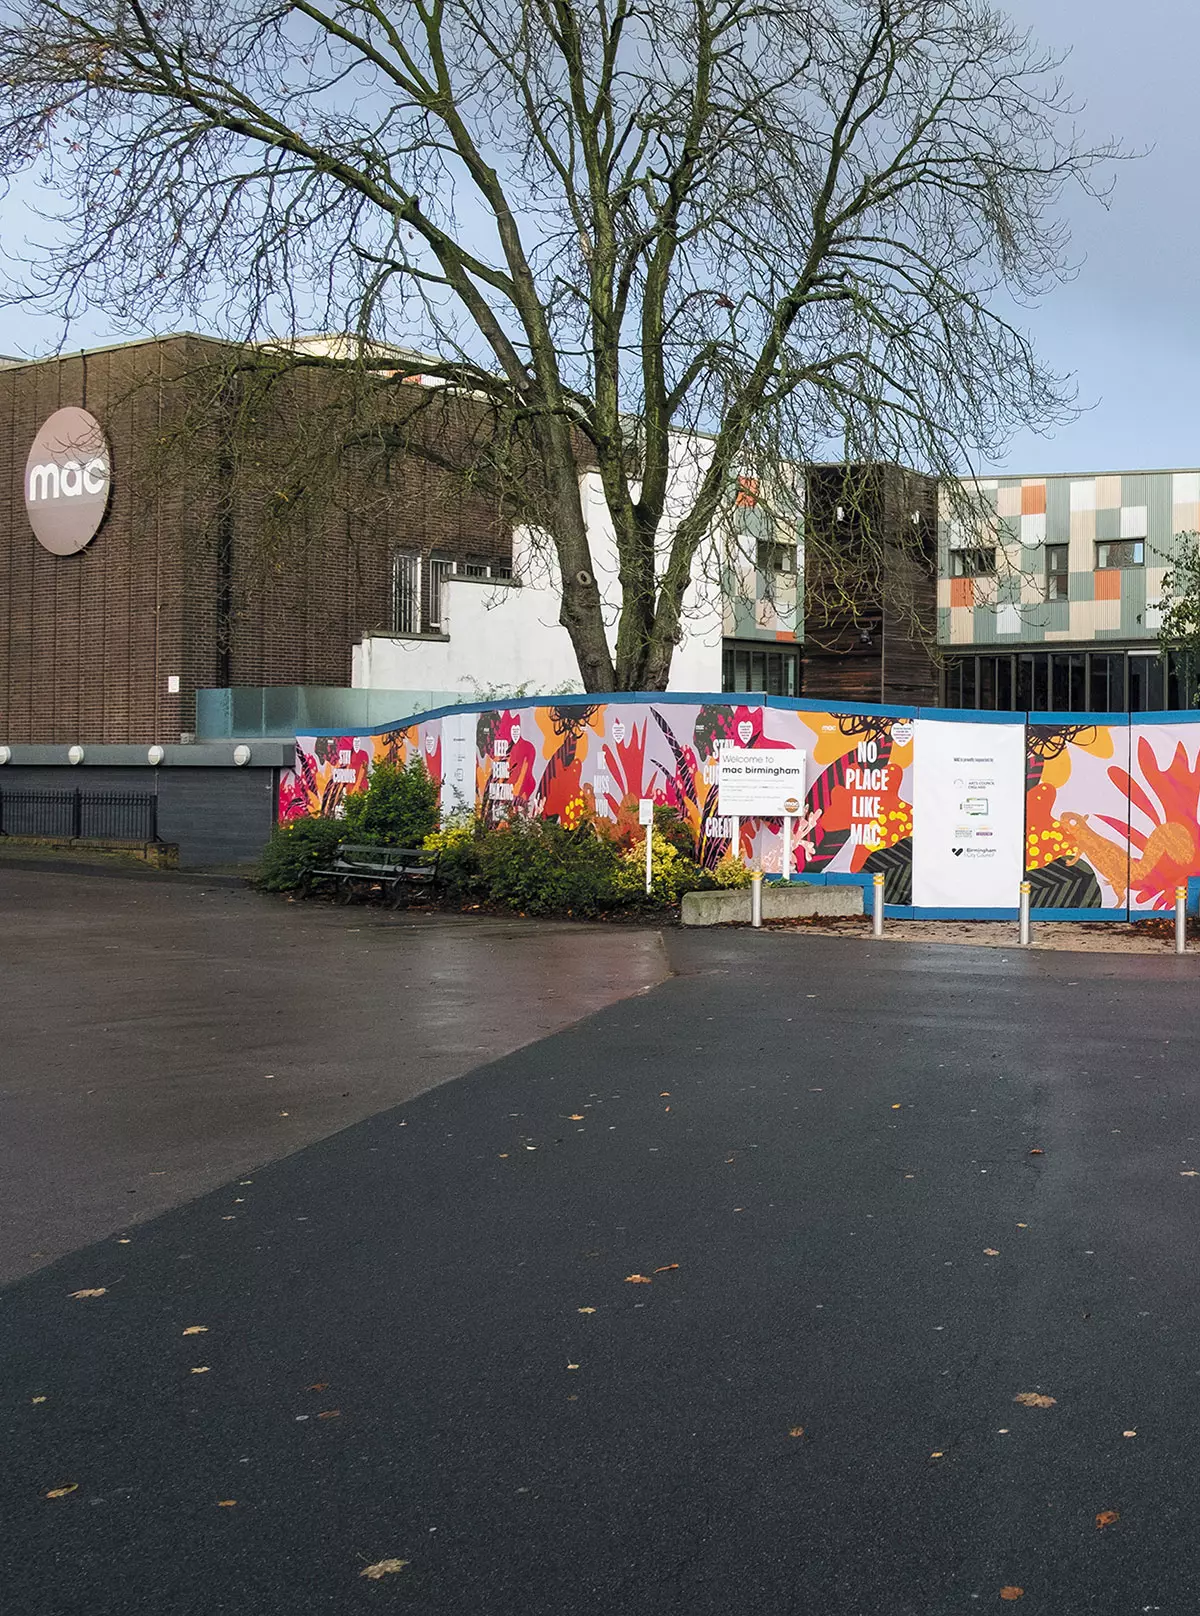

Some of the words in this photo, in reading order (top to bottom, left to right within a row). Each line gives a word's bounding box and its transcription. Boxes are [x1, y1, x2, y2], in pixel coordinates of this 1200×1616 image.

[29, 457, 105, 501] mac
[722, 754, 764, 764] Welcome
[765, 755, 775, 764] to
[857, 740, 878, 763] NO
[745, 766, 800, 777] birmingham
[845, 768, 889, 791] PLACE
[852, 795, 881, 817] LIKE
[850, 823, 881, 847] MAC
